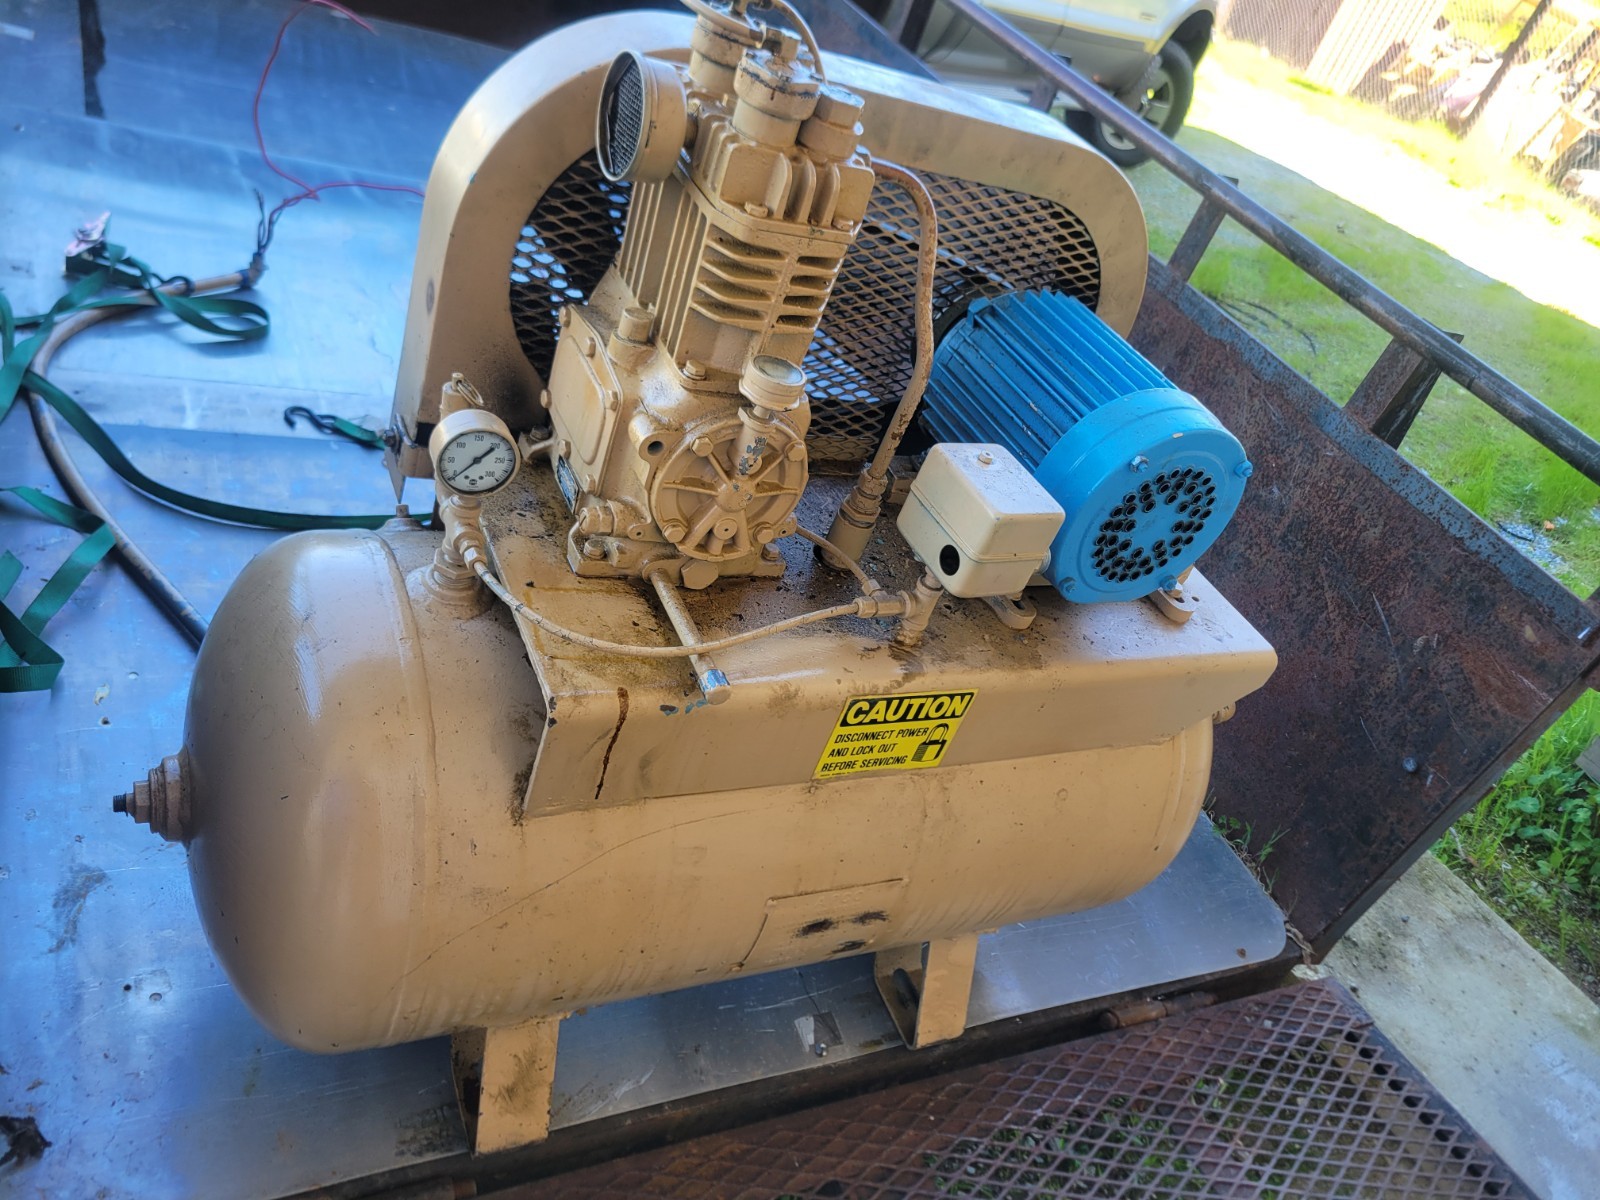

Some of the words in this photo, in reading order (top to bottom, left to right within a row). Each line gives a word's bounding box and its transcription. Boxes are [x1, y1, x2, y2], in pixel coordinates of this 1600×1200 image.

[846, 694, 971, 725] CAUTION
[834, 730, 895, 744] DISCONNECT
[896, 727, 928, 738] POWER
[828, 747, 848, 758] AND
[850, 745, 876, 756] LOCK
[878, 743, 898, 753] OUT
[820, 759, 858, 772] BEFORE
[860, 756, 908, 768] SERVICING
